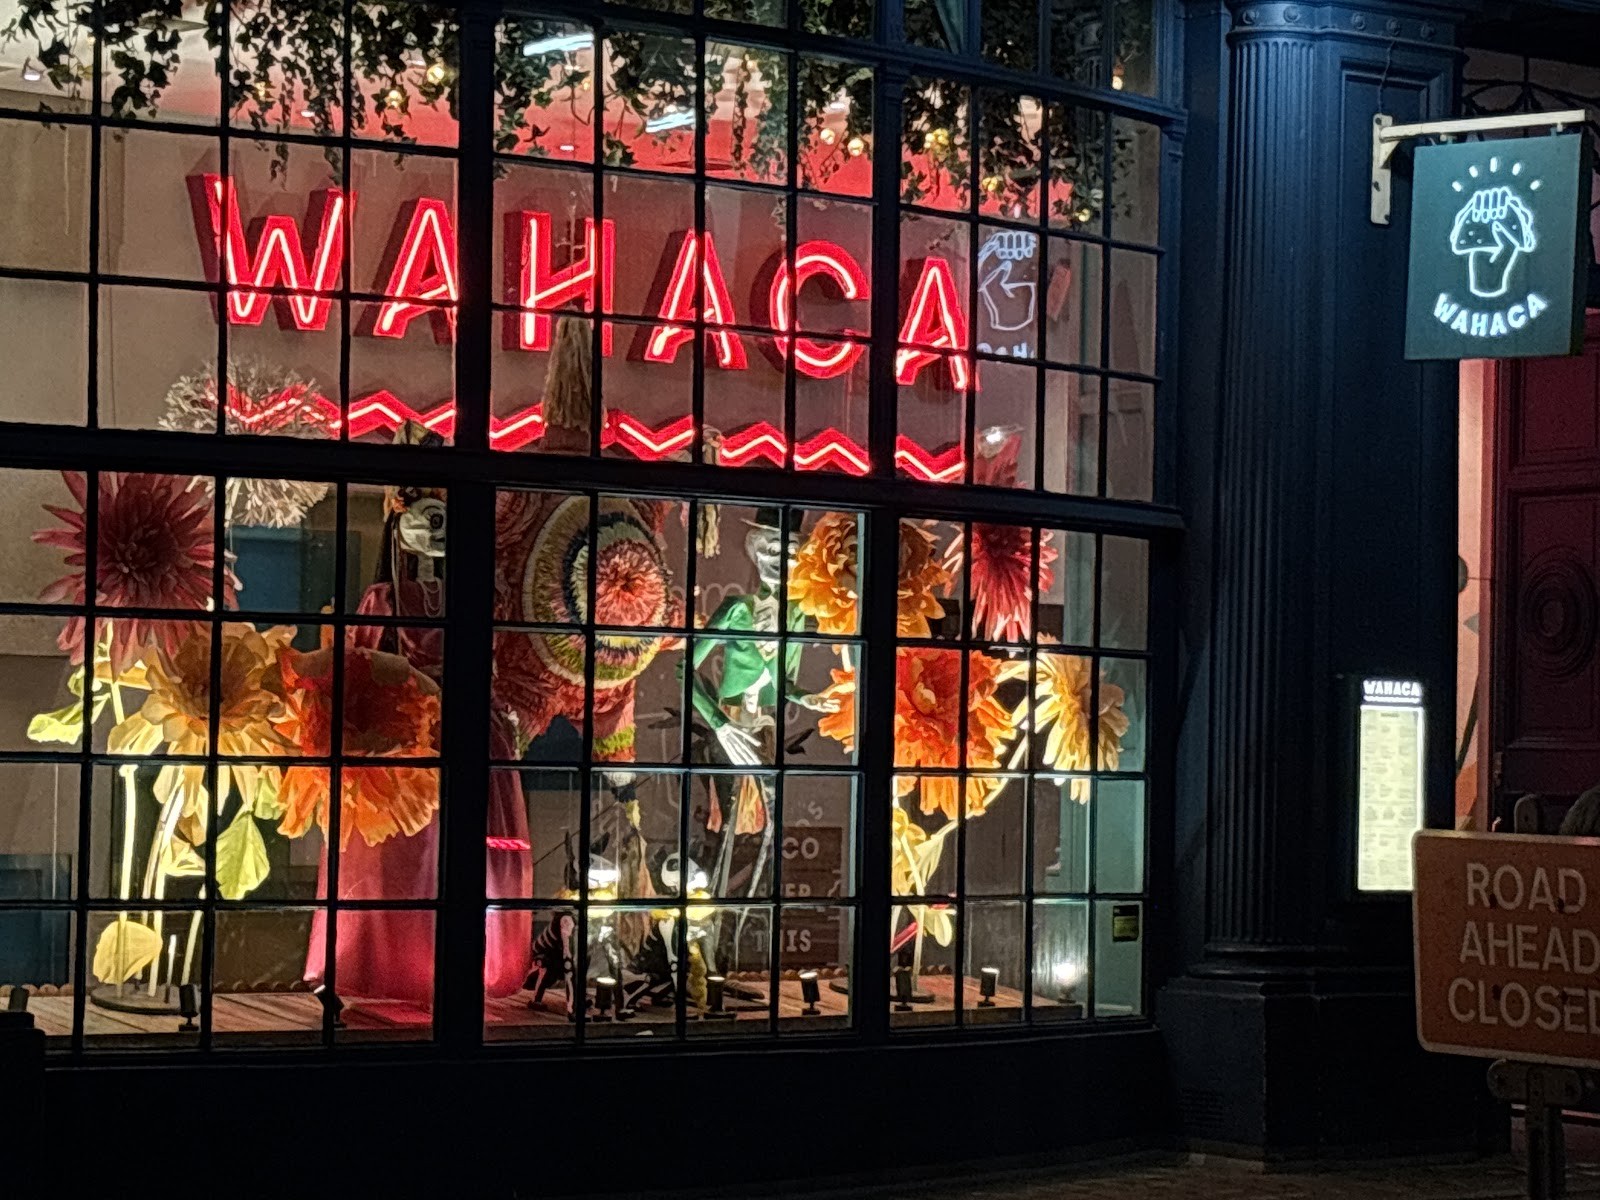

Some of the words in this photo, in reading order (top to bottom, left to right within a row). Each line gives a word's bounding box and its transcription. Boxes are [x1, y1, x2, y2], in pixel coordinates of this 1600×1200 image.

[187, 172, 981, 392] WAHACA
[1433, 292, 1548, 337] WAHACA
[1362, 679, 1422, 697] WAHACA
[1466, 862, 1588, 914] ROAD
[1459, 920, 1600, 975] AHEAD
